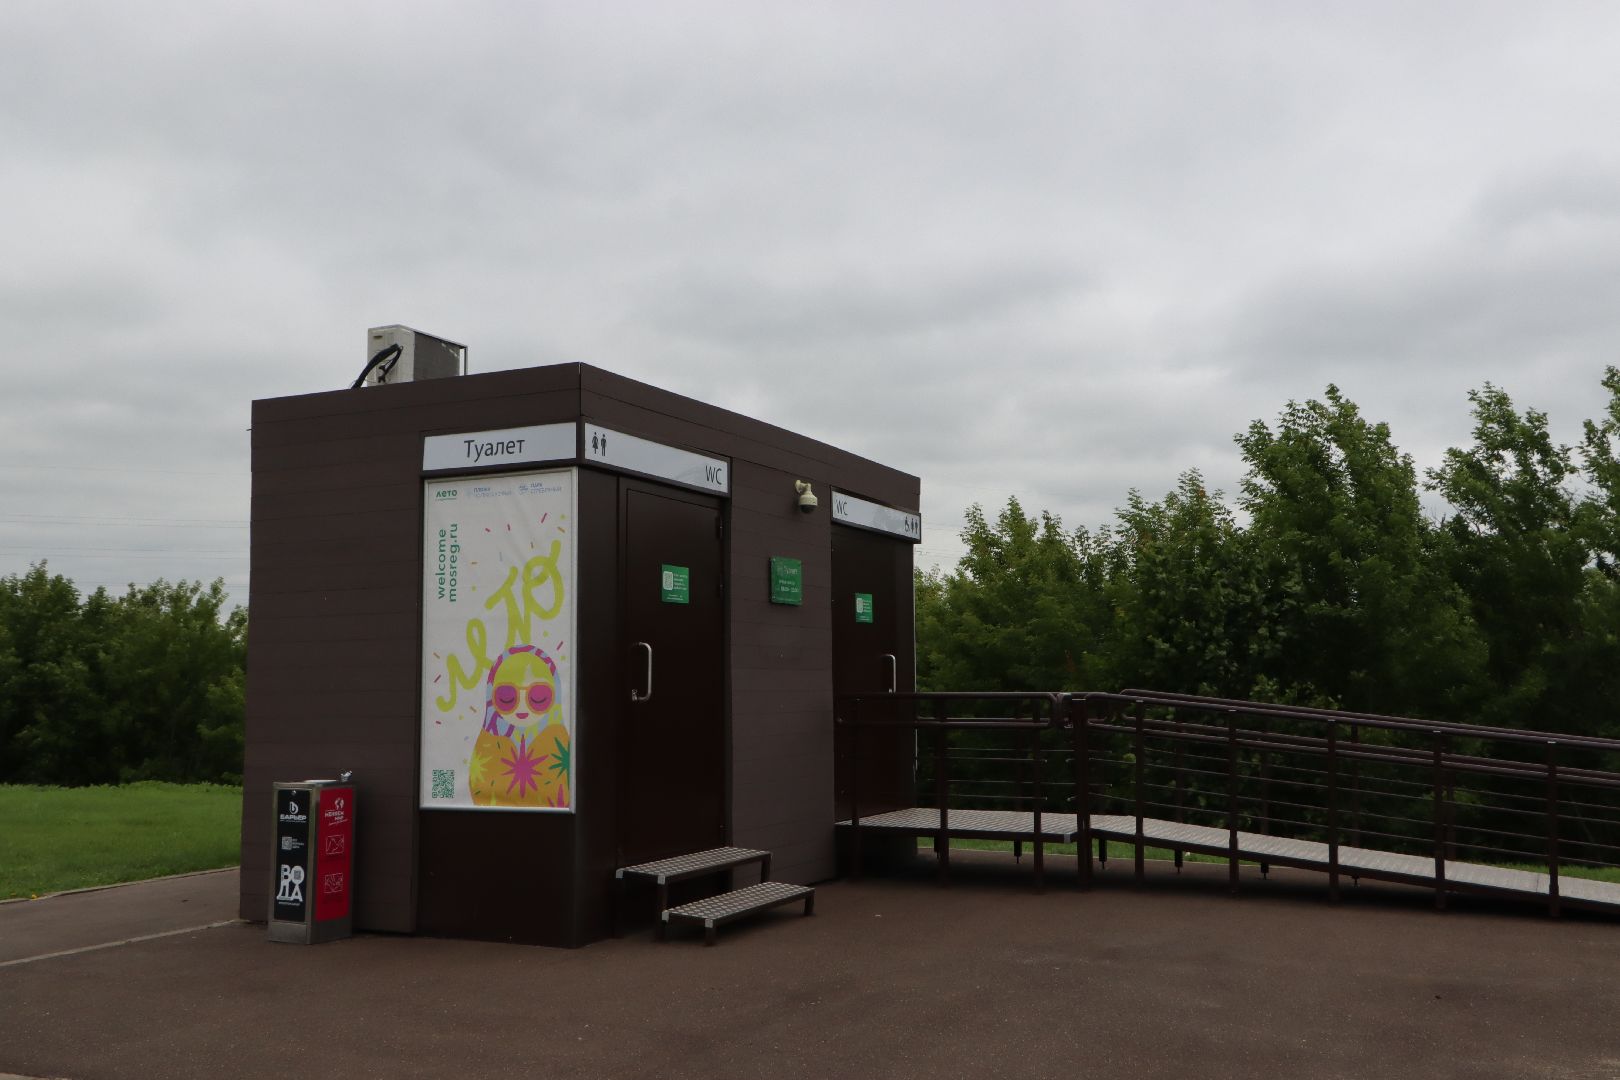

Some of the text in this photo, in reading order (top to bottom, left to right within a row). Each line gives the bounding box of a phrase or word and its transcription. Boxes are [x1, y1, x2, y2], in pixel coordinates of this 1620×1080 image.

[464, 439, 525, 463] Туалет
[705, 465, 722, 485] WC
[435, 489, 458, 497] лето
[835, 498, 848, 516] WC
[435, 529, 446, 600] welcome
[449, 523, 460, 602] mosreg.ru
